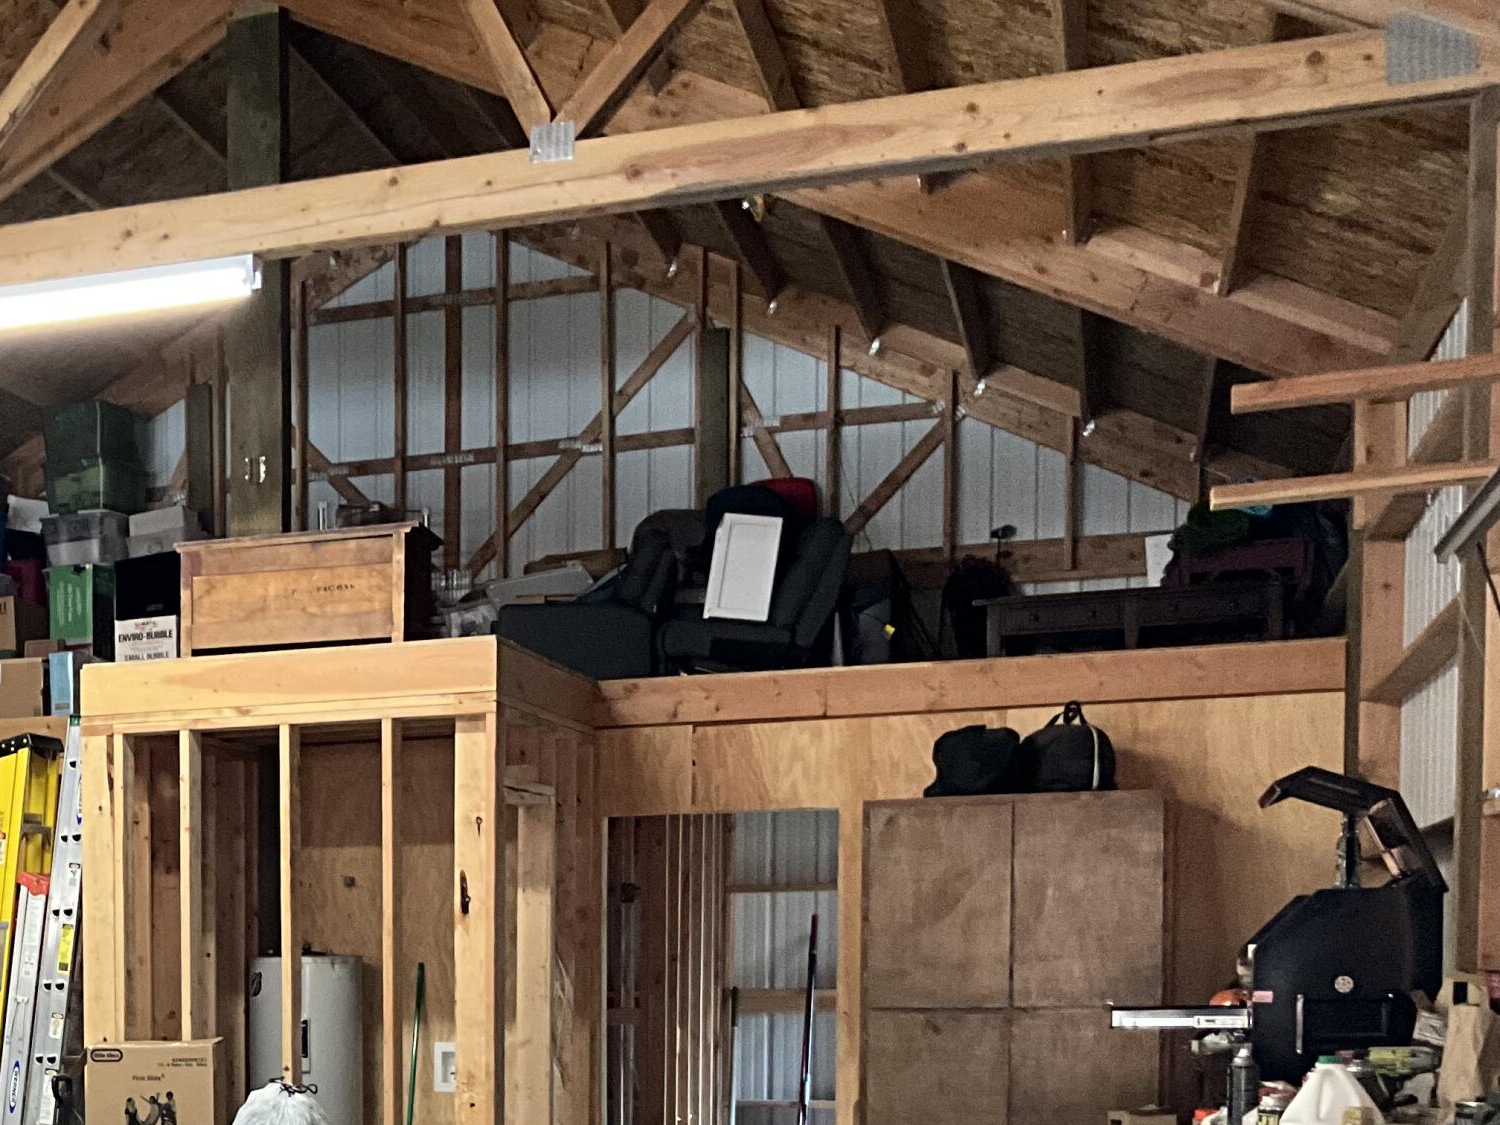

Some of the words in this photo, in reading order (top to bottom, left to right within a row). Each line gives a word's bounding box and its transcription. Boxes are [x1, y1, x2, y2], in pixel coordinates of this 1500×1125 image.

[118, 629, 173, 643] ENVIRO-BUBBLE
[125, 653, 145, 661] SMALL
[10, 1069, 21, 1104] WERNER
